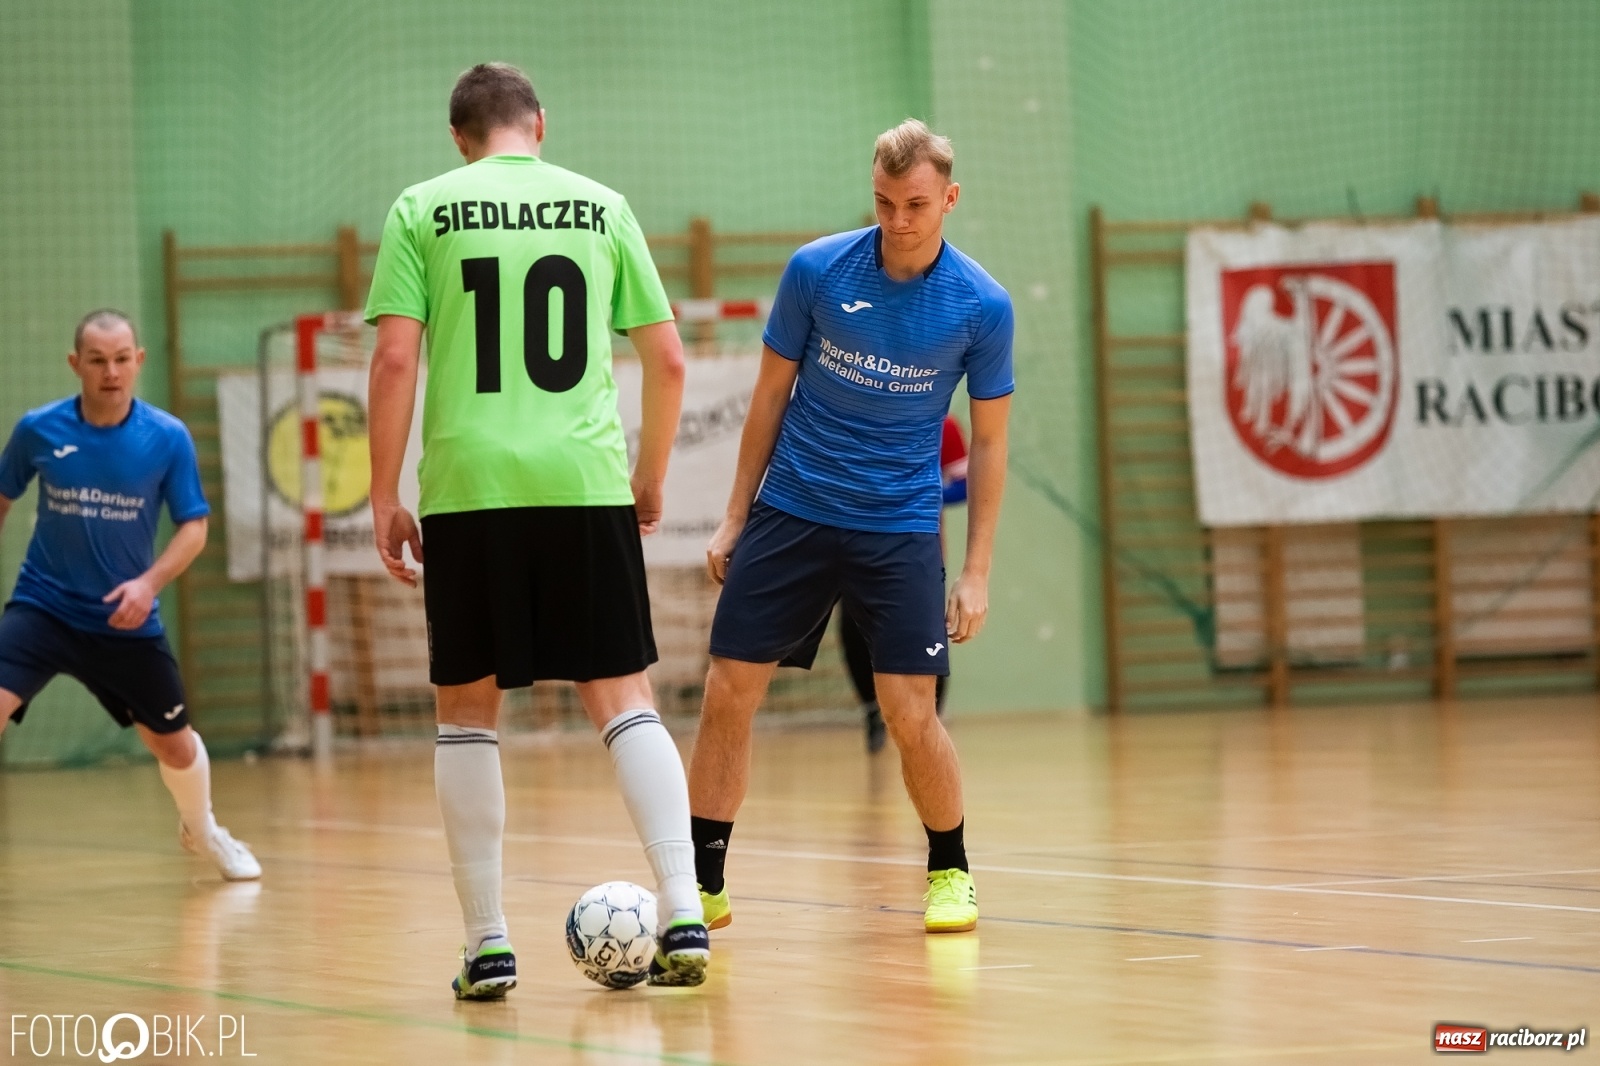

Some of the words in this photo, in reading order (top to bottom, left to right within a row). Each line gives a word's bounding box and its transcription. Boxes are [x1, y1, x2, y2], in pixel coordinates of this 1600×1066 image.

[433, 200, 606, 238] SIEDLACZEK
[461, 254, 588, 394] 10
[1447, 306, 1600, 354] MIAS
[817, 352, 884, 390] Metallbau
[888, 380, 934, 393] GmbH
[820, 337, 941, 379] Marek&Dariusz
[1415, 374, 1600, 427] RACIB
[101, 506, 139, 521] GmbH
